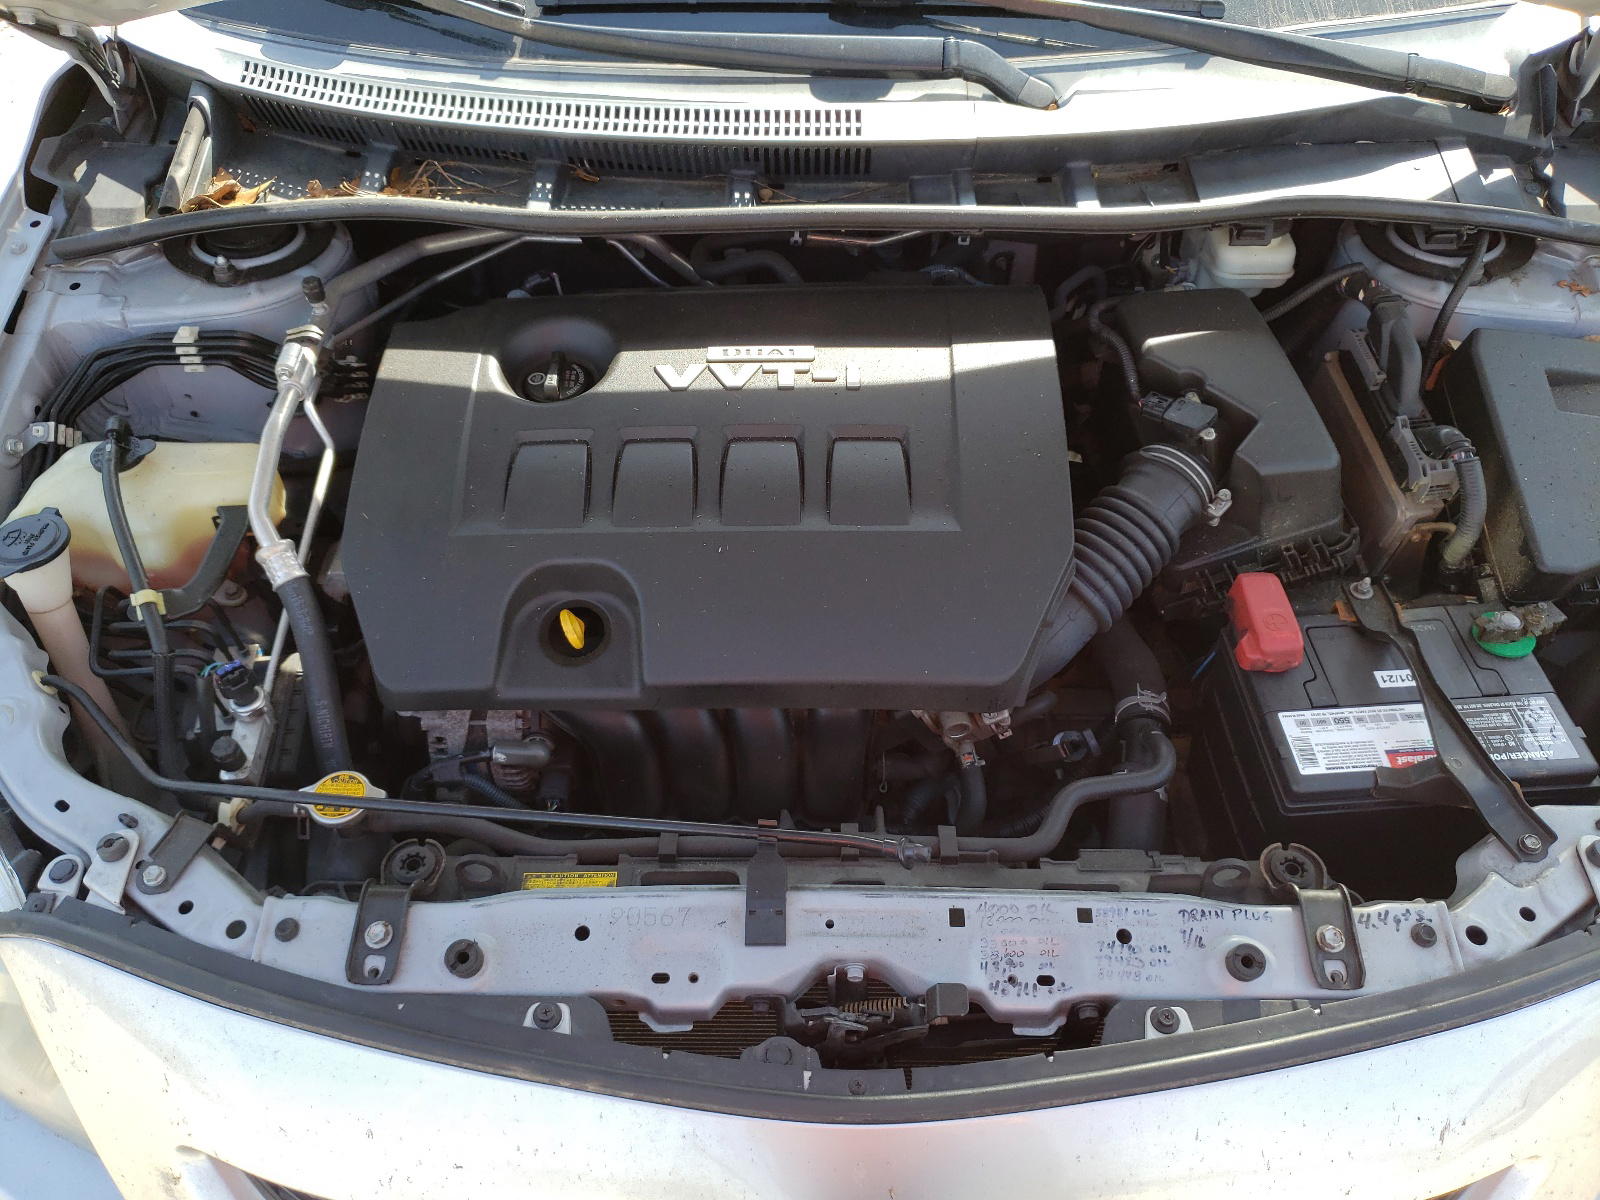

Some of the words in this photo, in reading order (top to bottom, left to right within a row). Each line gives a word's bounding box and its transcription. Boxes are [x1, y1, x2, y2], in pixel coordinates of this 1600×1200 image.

[1380, 674, 1416, 685] 01/21
[1395, 753, 1437, 767] uralast
[1178, 908, 1225, 922] DRAIN
[1232, 908, 1273, 922] PLUG
